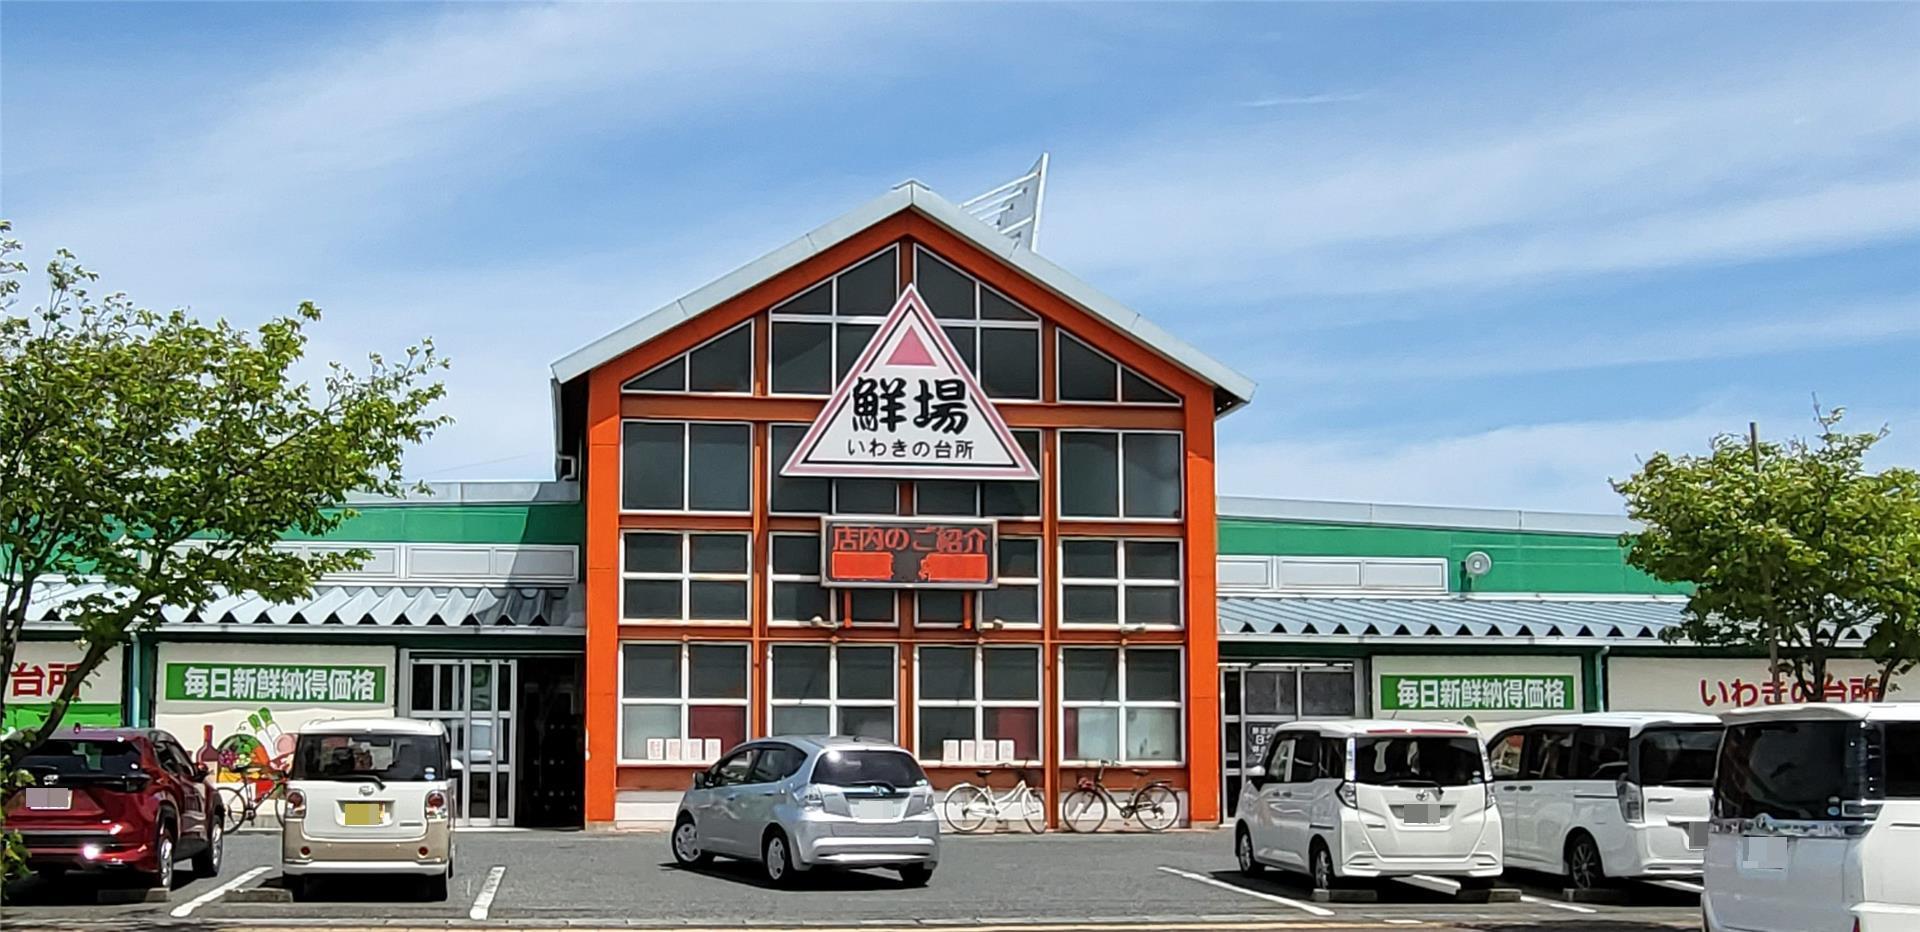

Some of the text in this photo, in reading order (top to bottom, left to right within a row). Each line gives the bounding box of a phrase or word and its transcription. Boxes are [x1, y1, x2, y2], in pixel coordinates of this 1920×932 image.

[852, 376, 969, 435] 鮮場
[847, 438, 974, 459] いわきの台所
[833, 526, 987, 553] 店内のご紹介
[184, 667, 376, 700] 毎日新鮮納得価格
[1397, 678, 1565, 709] 毎日新鮮納得価格
